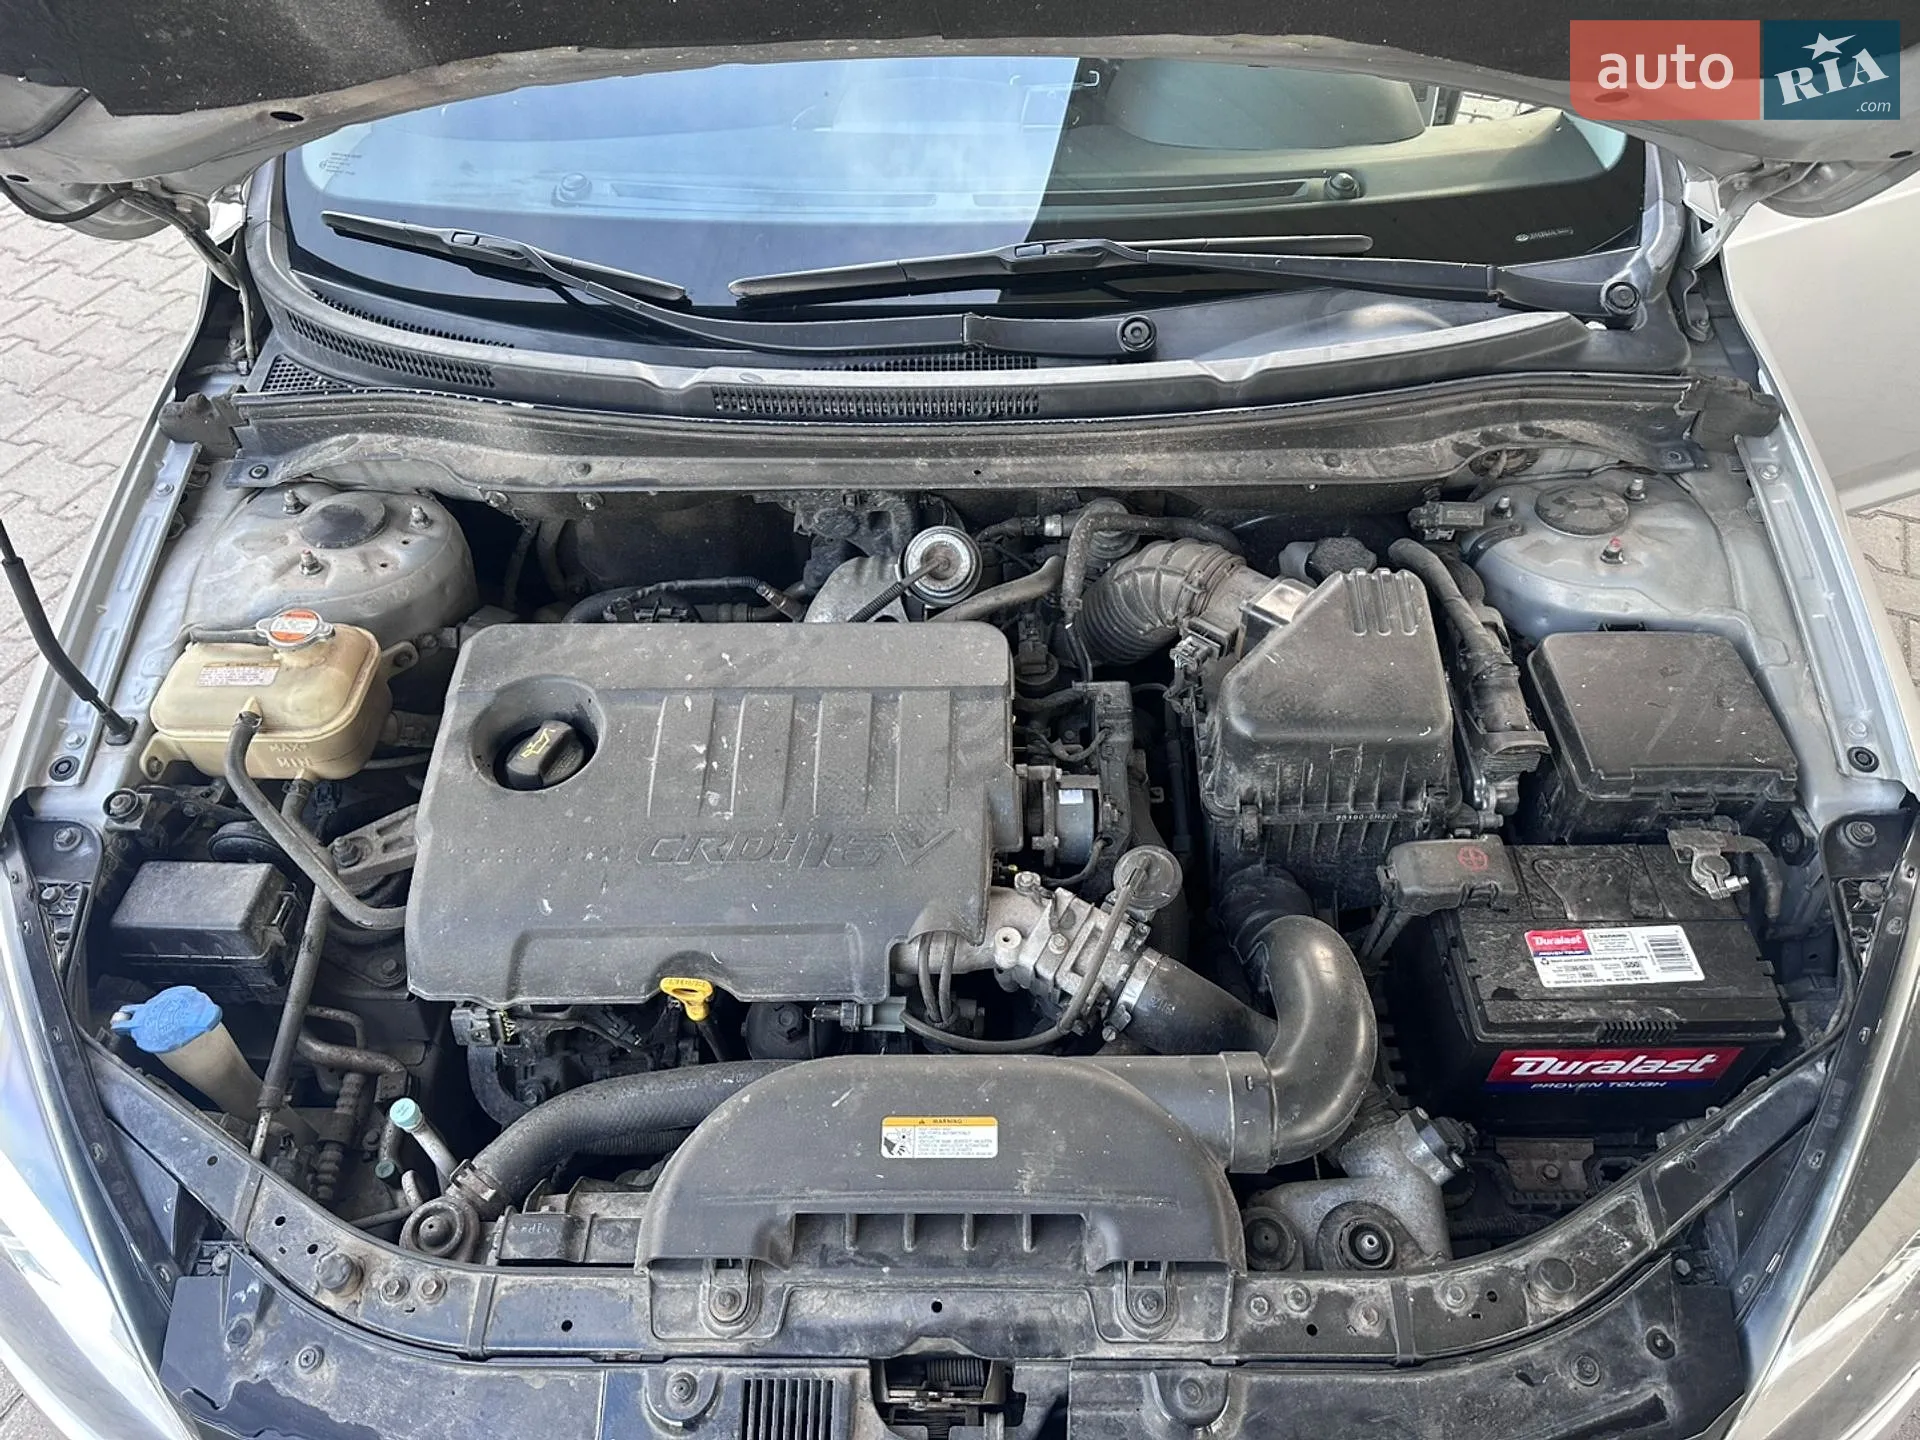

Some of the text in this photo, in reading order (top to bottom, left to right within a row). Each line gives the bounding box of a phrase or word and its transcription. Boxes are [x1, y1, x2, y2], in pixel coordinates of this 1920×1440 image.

[1531, 935, 1583, 947] Duralast
[1510, 1053, 1720, 1077] Duralast
[1530, 1080, 1668, 1090] PROVEN TOUGH
